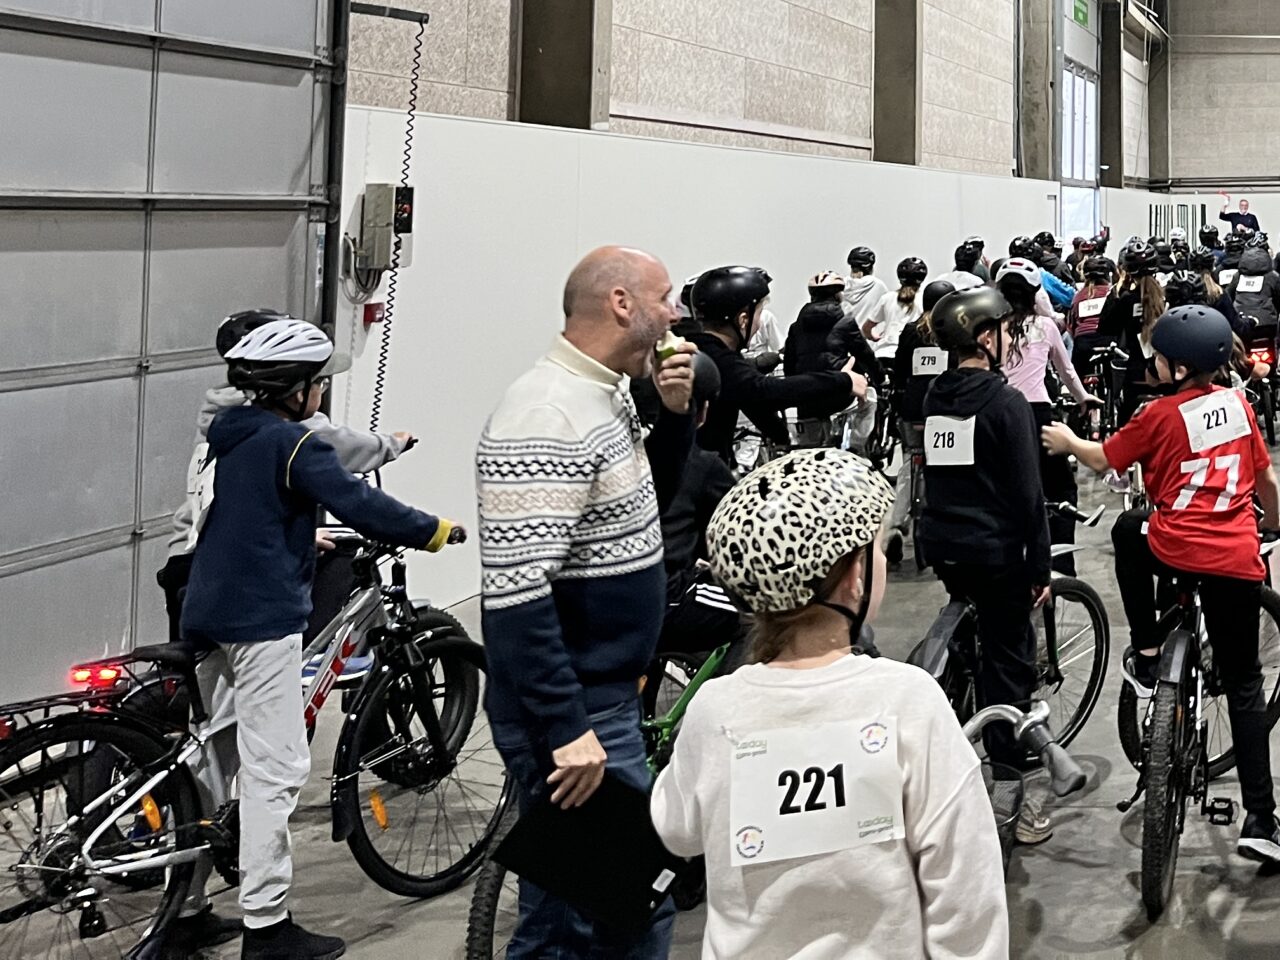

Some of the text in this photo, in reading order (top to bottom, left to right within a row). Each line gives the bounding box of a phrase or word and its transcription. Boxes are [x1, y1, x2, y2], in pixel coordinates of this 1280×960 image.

[920, 355, 937, 366] 279
[1203, 407, 1229, 431] 227
[933, 431, 955, 449] 218
[1171, 453, 1241, 512] 77
[778, 763, 846, 816] 221
